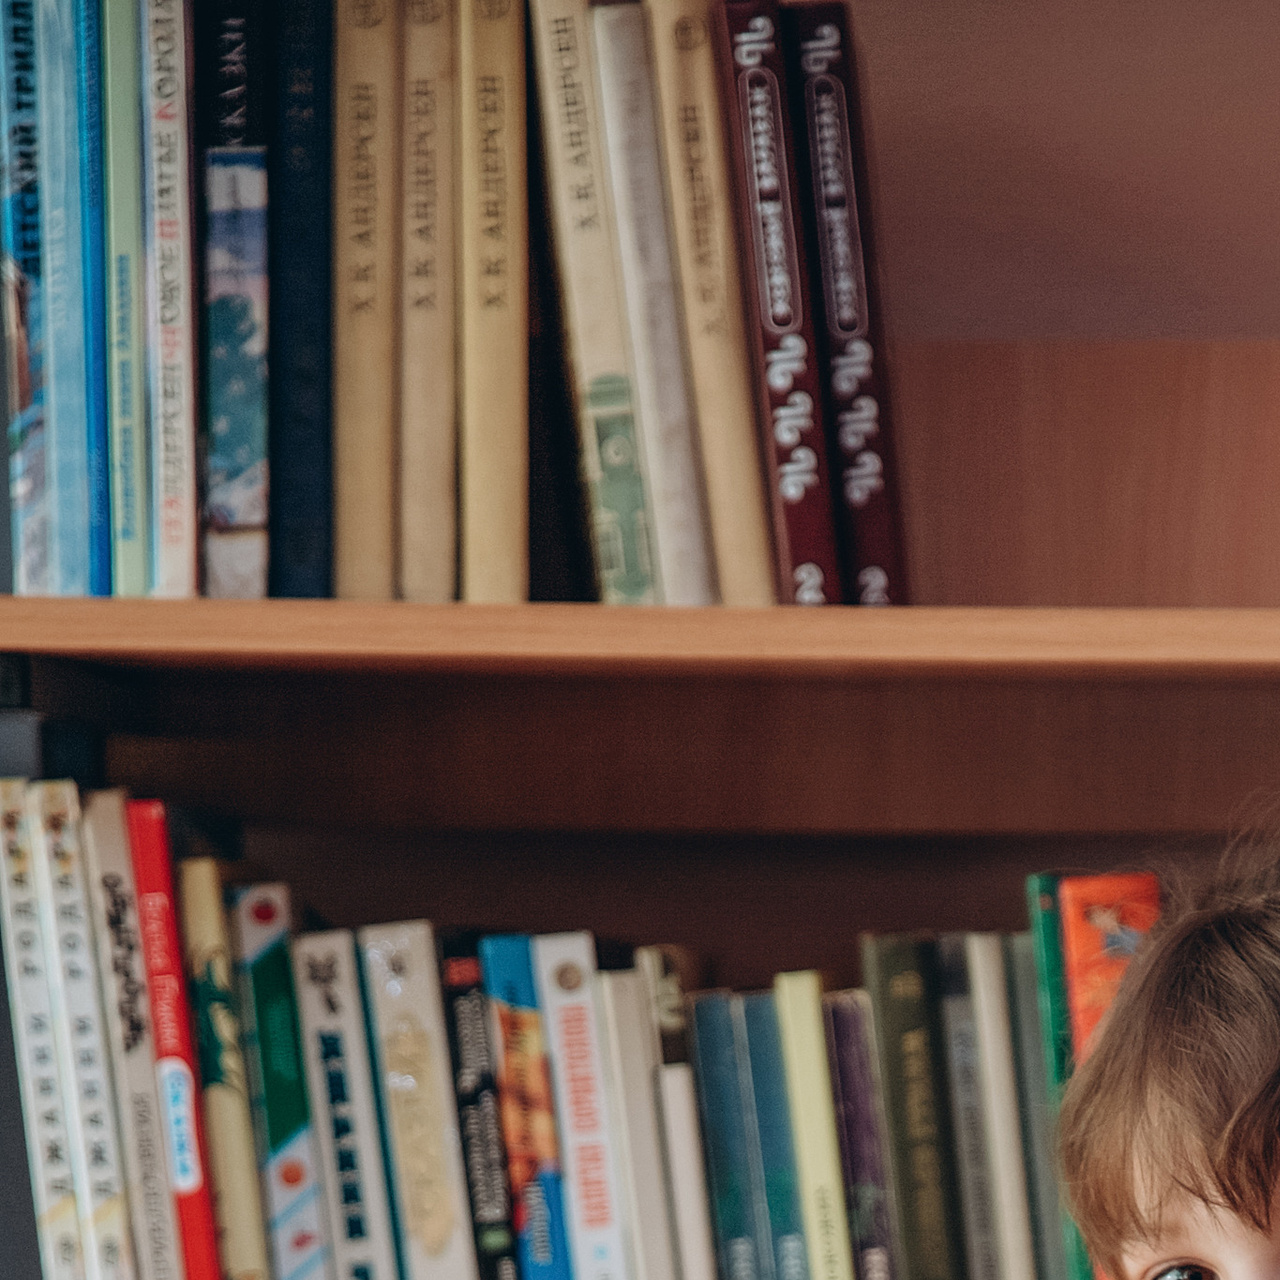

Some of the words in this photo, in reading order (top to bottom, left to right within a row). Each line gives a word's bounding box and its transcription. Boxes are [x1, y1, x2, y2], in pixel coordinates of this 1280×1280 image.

[349, 82, 376, 248] АНДЕРСЕН
[411, 78, 436, 243] АНДЕРСЕН
[478, 76, 506, 241] АНДЕРСЕН
[547, 15, 592, 170] АНДЕРСЕН
